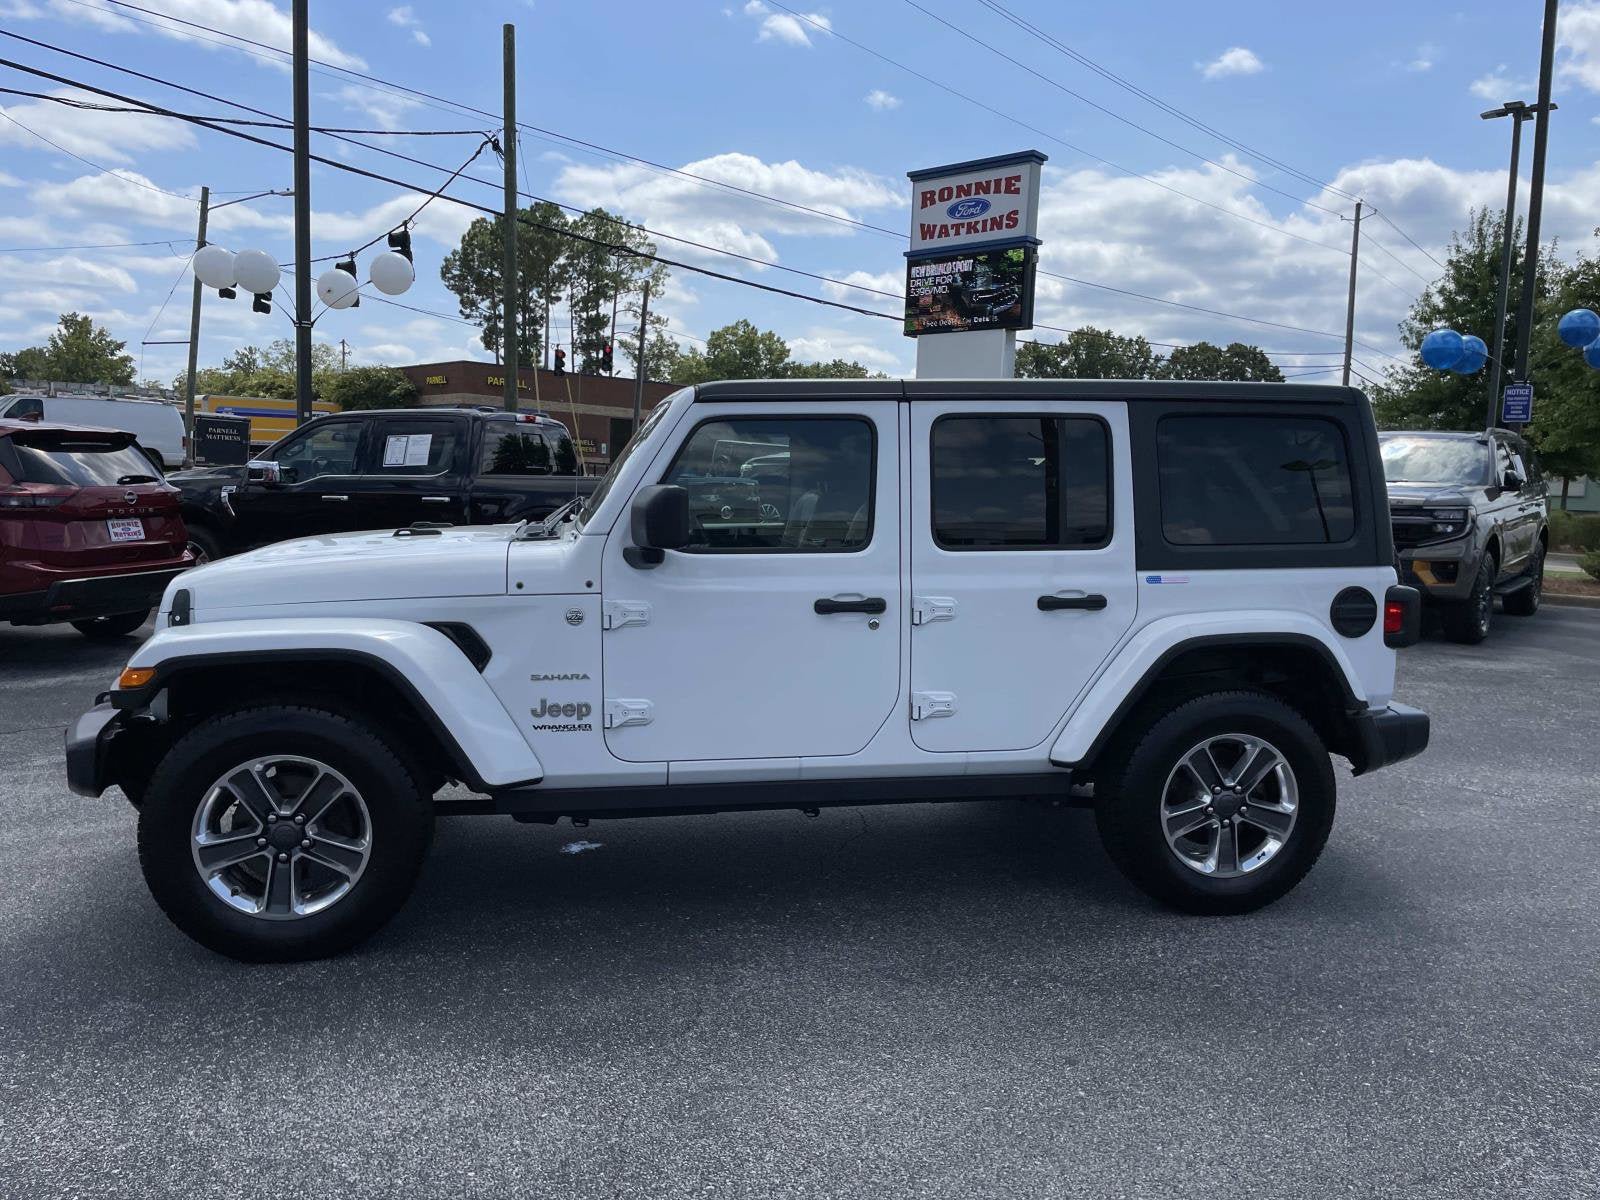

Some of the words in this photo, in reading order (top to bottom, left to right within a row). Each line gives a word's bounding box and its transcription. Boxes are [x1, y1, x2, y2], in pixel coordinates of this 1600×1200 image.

[920, 175, 1021, 209] RONNIE
[955, 201, 982, 218] Ford
[919, 209, 1019, 240] WATKINS
[910, 277, 935, 288] DRIVE
[935, 274, 953, 285] FOR
[425, 375, 447, 385] PARNELL
[487, 376, 527, 388] PARLL
[206, 433, 241, 441] MATTRESS
[208, 427, 239, 435] PARNELL
[530, 673, 591, 681] SAHARA
[530, 698, 592, 721] Jeep
[532, 723, 592, 731] WRANGLER
